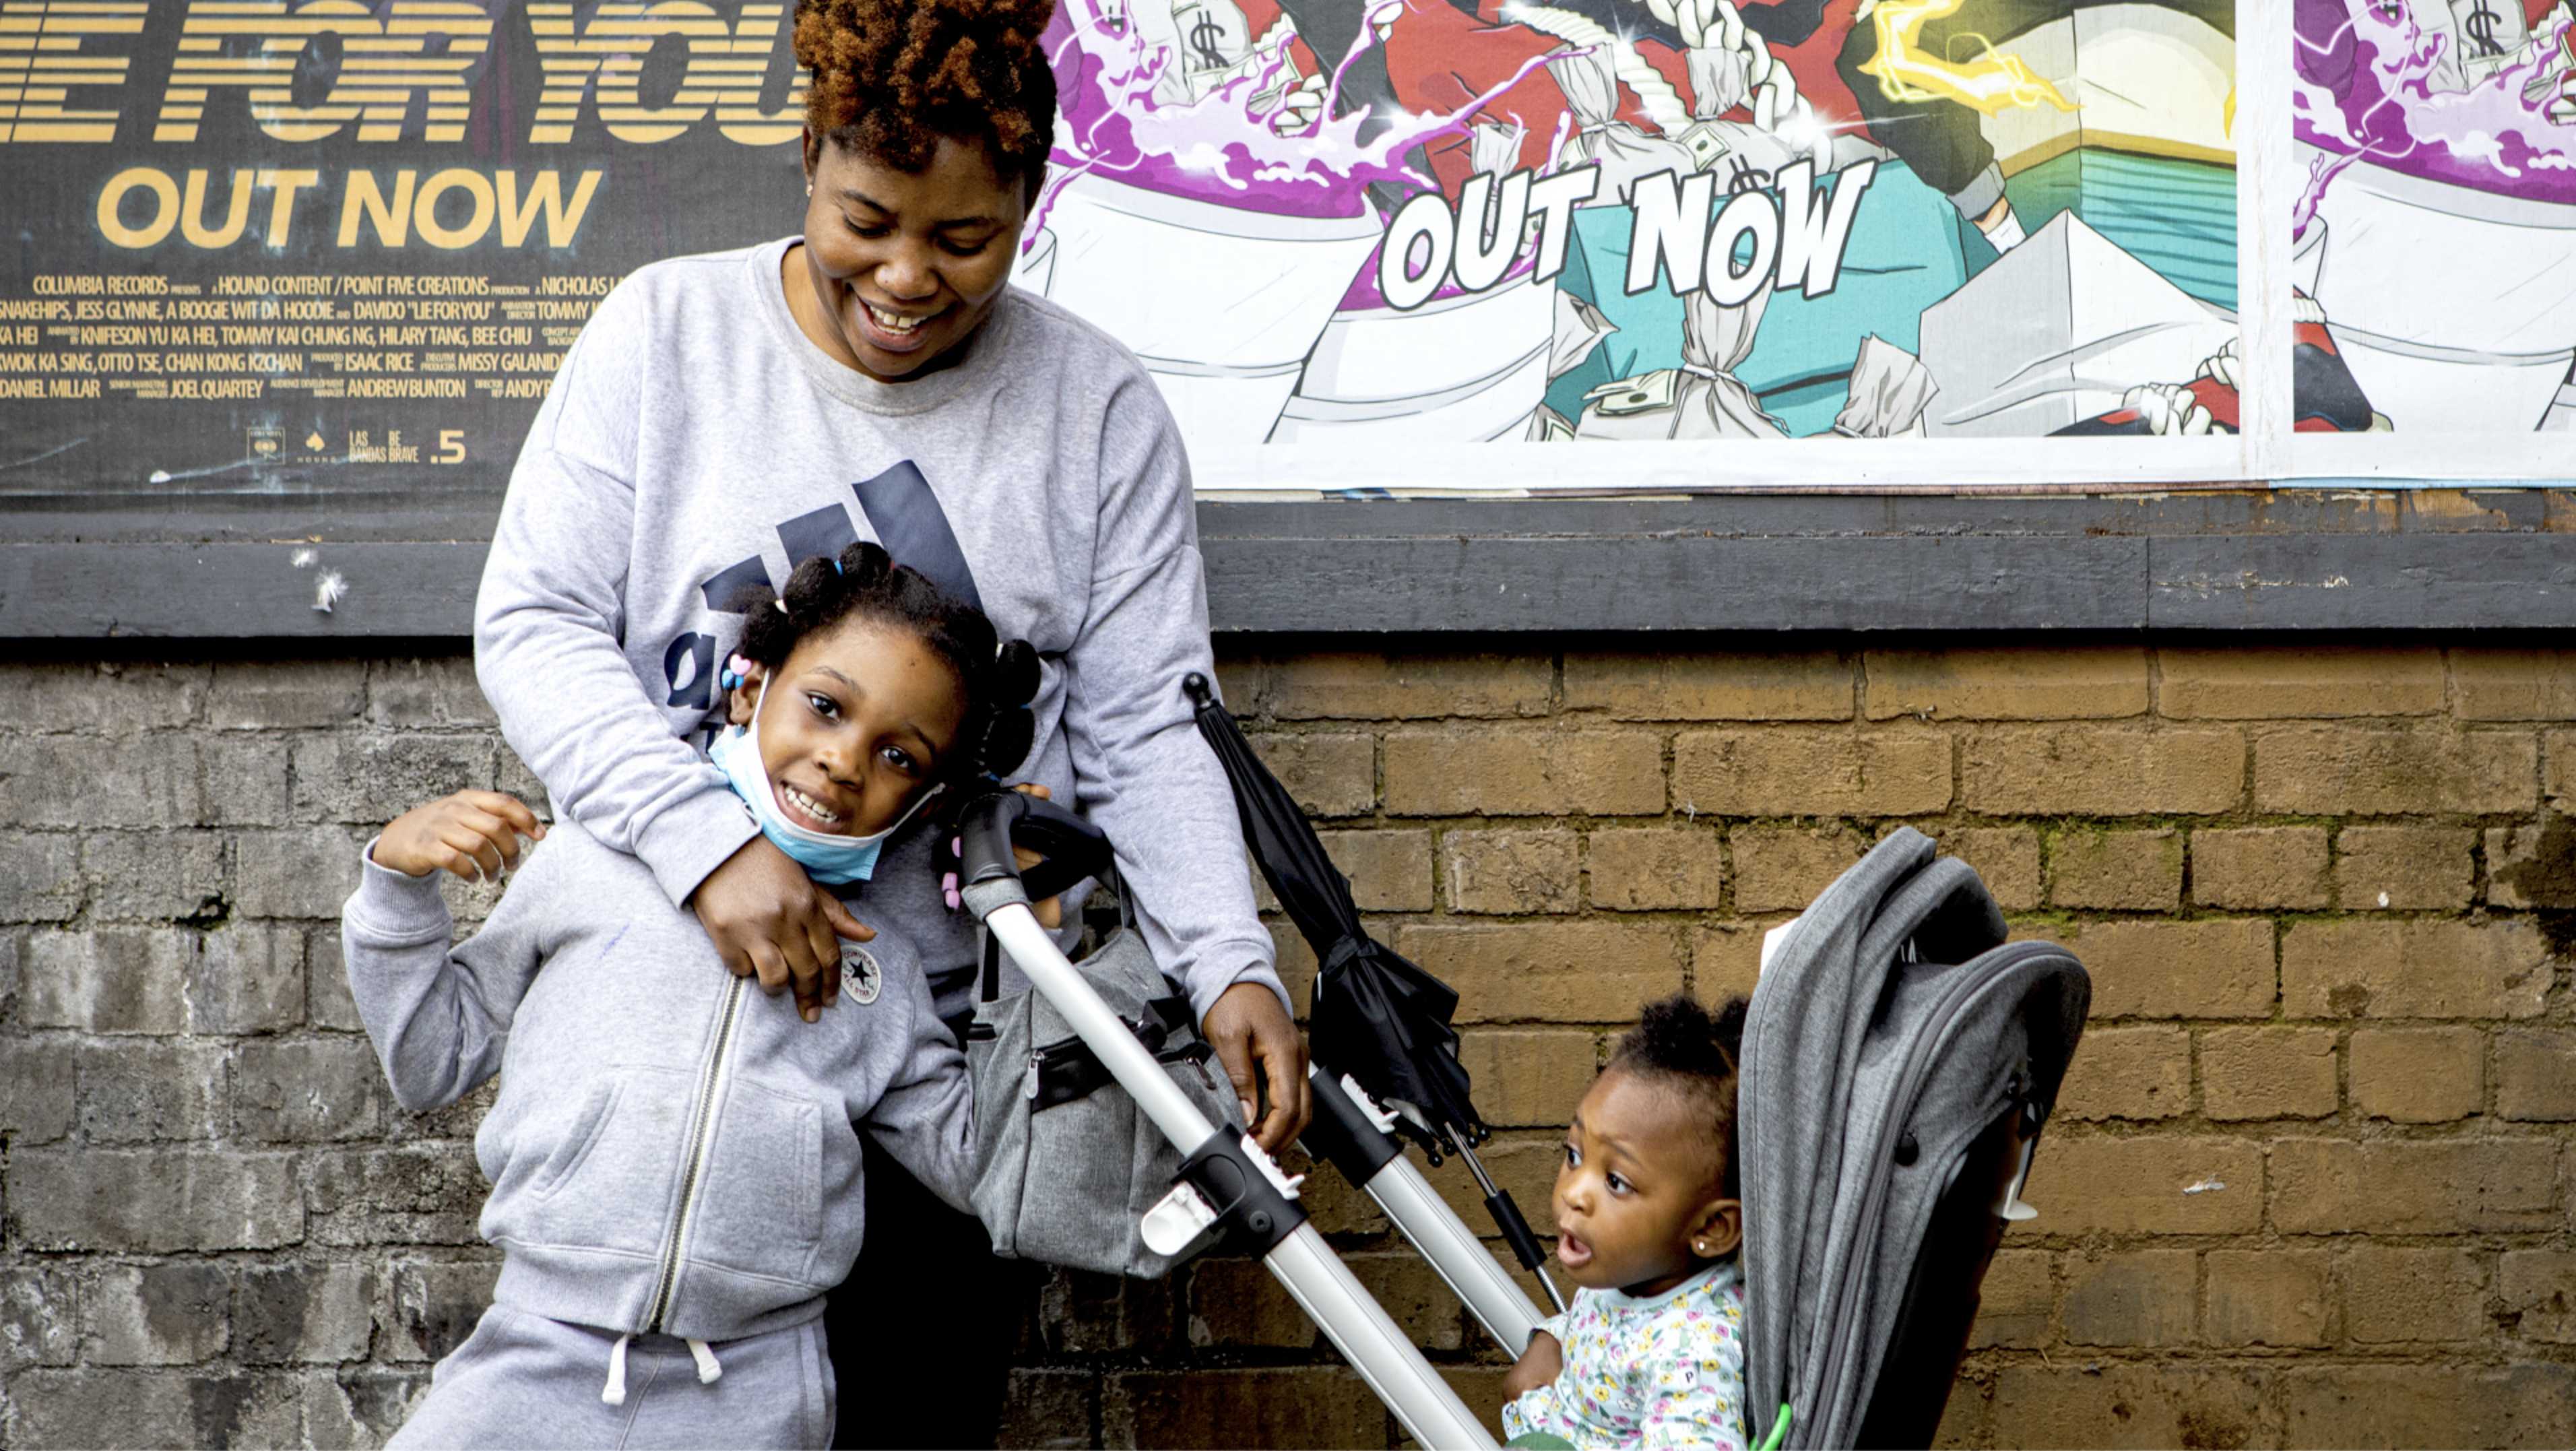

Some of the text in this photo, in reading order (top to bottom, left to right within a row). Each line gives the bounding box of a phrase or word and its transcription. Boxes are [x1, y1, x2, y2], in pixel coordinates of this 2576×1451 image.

[154, 0, 494, 141] FOR
[527, 0, 812, 145] YOU
[97, 168, 603, 249] OUT NOW
[1378, 158, 1878, 310] OUT NOW
[34, 276, 105, 294] COLUMBIA
[108, 276, 168, 294] RECORDS
[219, 276, 269, 294] HOUND
[272, 276, 333, 294] CONTENT
[344, 276, 384, 295] POINT
[387, 277, 415, 295] FIVE
[417, 277, 489, 295] CREATIONS
[542, 276, 608, 295] NICHOLAS
[75, 300, 104, 319] JESS
[106, 301, 164, 322] GLYNNE,
[166, 301, 176, 319] A
[179, 301, 229, 319] BOOGIE
[231, 301, 258, 320] WIT
[261, 301, 281, 320] DA
[284, 301, 334, 320] HOODIE
[354, 301, 406, 320] DAVIDO
[536, 302, 589, 320] TOMMY
[16, 326, 38, 345] HEI
[81, 326, 532, 348] KNIFESON YU KA HEI, TOMMY KAI CHUNG NG, HILARY TANG, BEE CHIU
[38, 353, 58, 371] KA
[60, 353, 97, 375] SING,
[98, 353, 134, 372] OTTO
[136, 353, 163, 375] TSE,
[166, 353, 203, 372] CHAN
[207, 353, 245, 372] KONG
[248, 353, 302, 372] KZCHAN
[346, 353, 414, 371] ISAAC RICE
[459, 353, 500, 371] MISSY
[0, 379, 100, 398] DANIEL MILLAR
[170, 379, 264, 400] JOEL QUARTEY
[347, 379, 466, 397] ANDREW BUNTON
[505, 379, 544, 397] ANDY
[350, 430, 401, 446] LAS BE
[349, 447, 419, 463] BANDAS BRAVE
[1685, 1372, 1694, 1384] P
